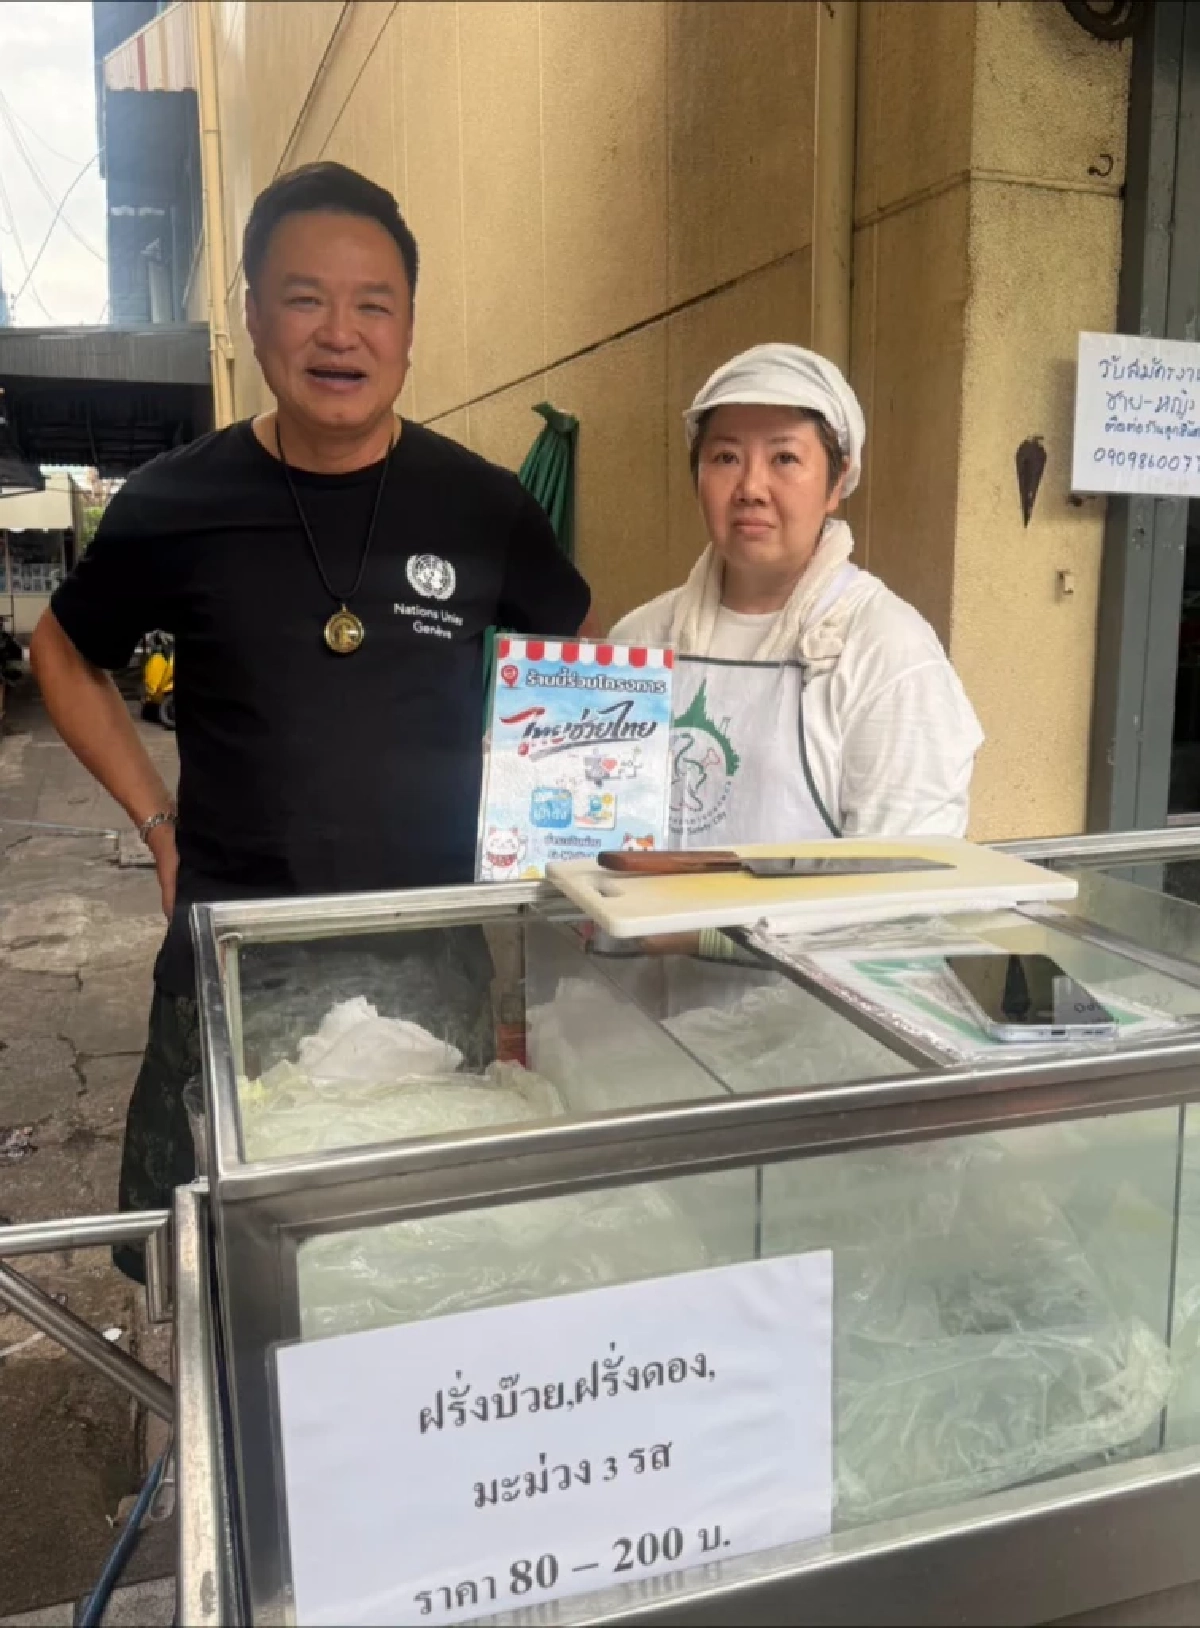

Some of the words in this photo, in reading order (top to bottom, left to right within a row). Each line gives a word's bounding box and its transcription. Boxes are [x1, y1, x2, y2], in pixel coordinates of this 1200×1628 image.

[393, 602, 439, 620] Nations
[473, 1451, 591, 1509] มะม่วง
[601, 1455, 618, 1482] 3
[627, 1440, 674, 1474] รส
[413, 1575, 497, 1616] ราคา
[508, 1552, 560, 1596] 80
[611, 1525, 684, 1573] 200
[697, 1525, 732, 1552] บ.
